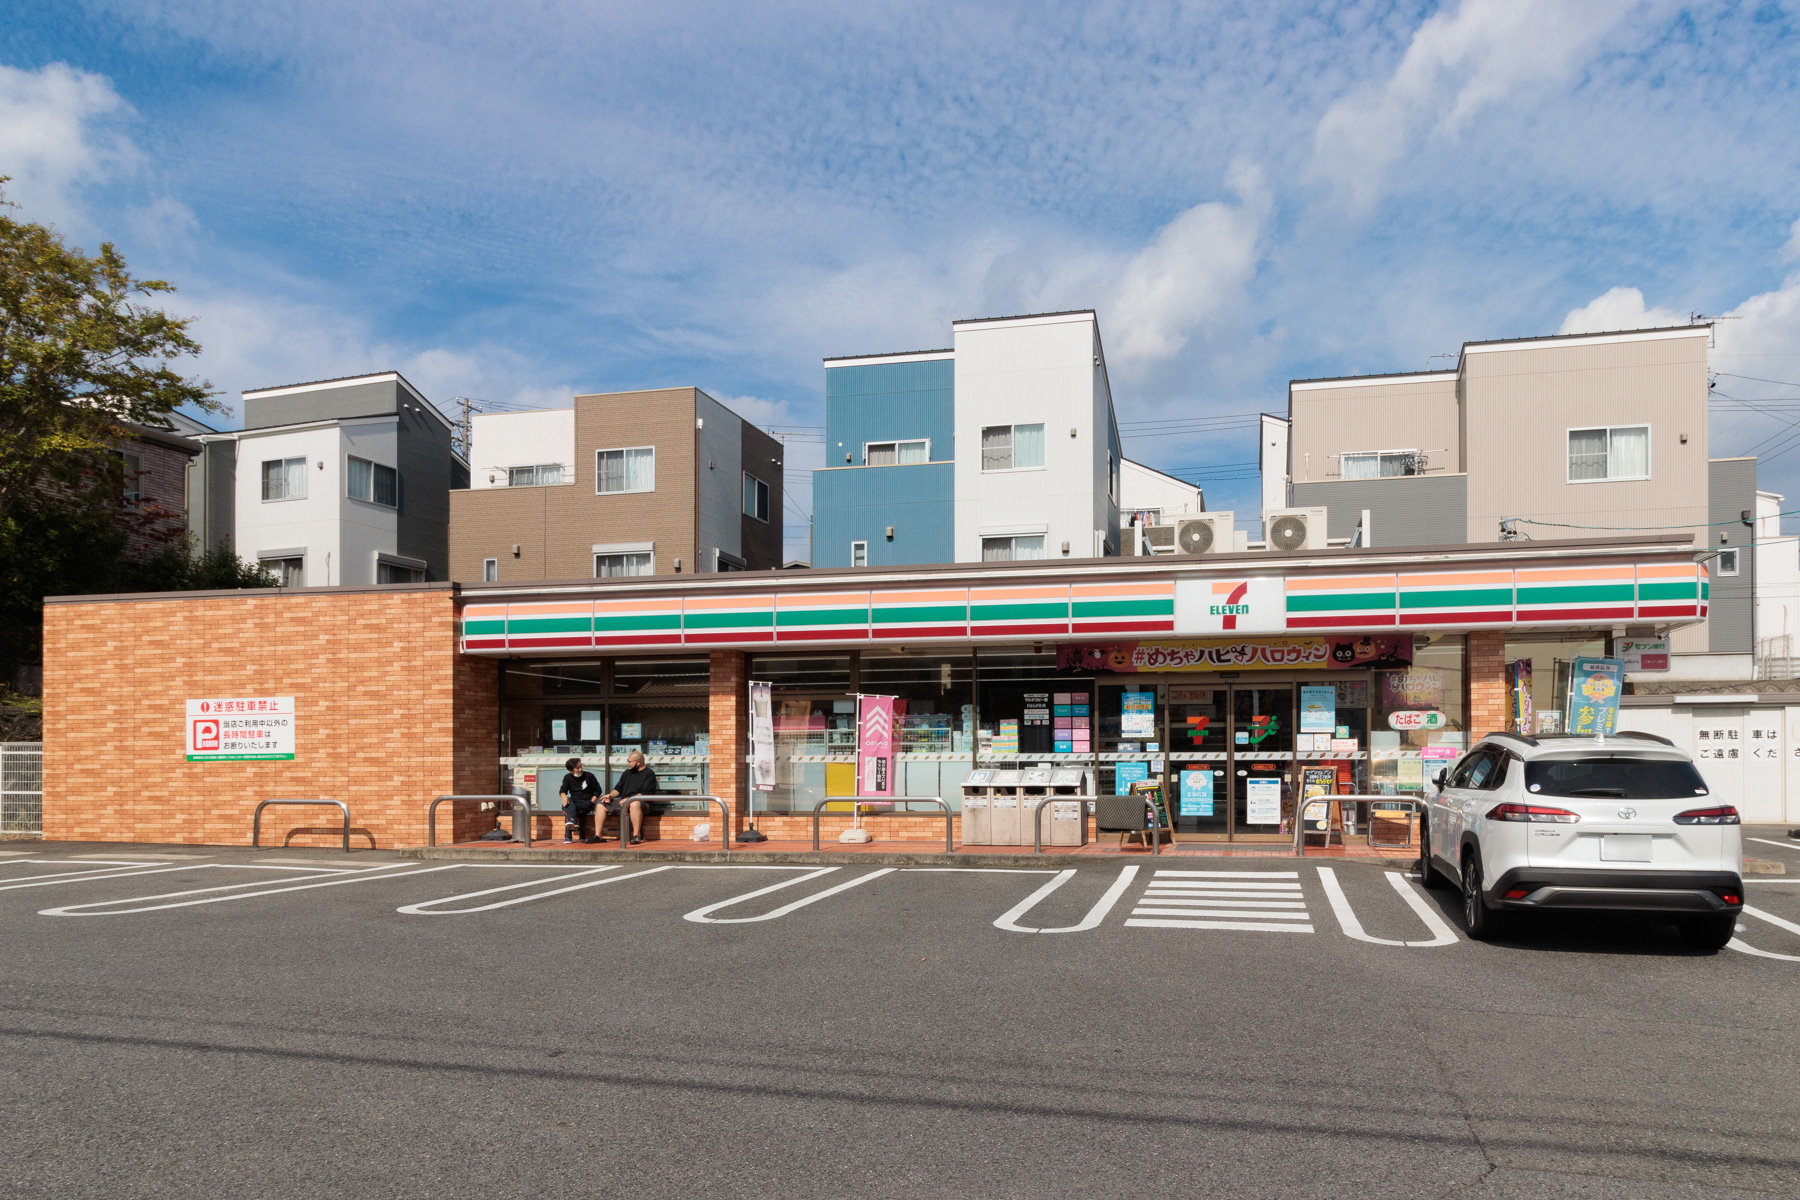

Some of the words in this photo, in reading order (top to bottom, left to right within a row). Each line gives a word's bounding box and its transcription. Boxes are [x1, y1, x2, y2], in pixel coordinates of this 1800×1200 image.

[1634, 643, 1666, 651] セブン銀行
[213, 700, 279, 712] 迷惑駐車禁止
[223, 719, 288, 728] 当店ご利用中以外の
[1395, 713, 1422, 725] たばこ
[1426, 713, 1439, 725] 酒
[223, 730, 271, 739] 長時間駐車は
[223, 741, 279, 750] お断りいたします
